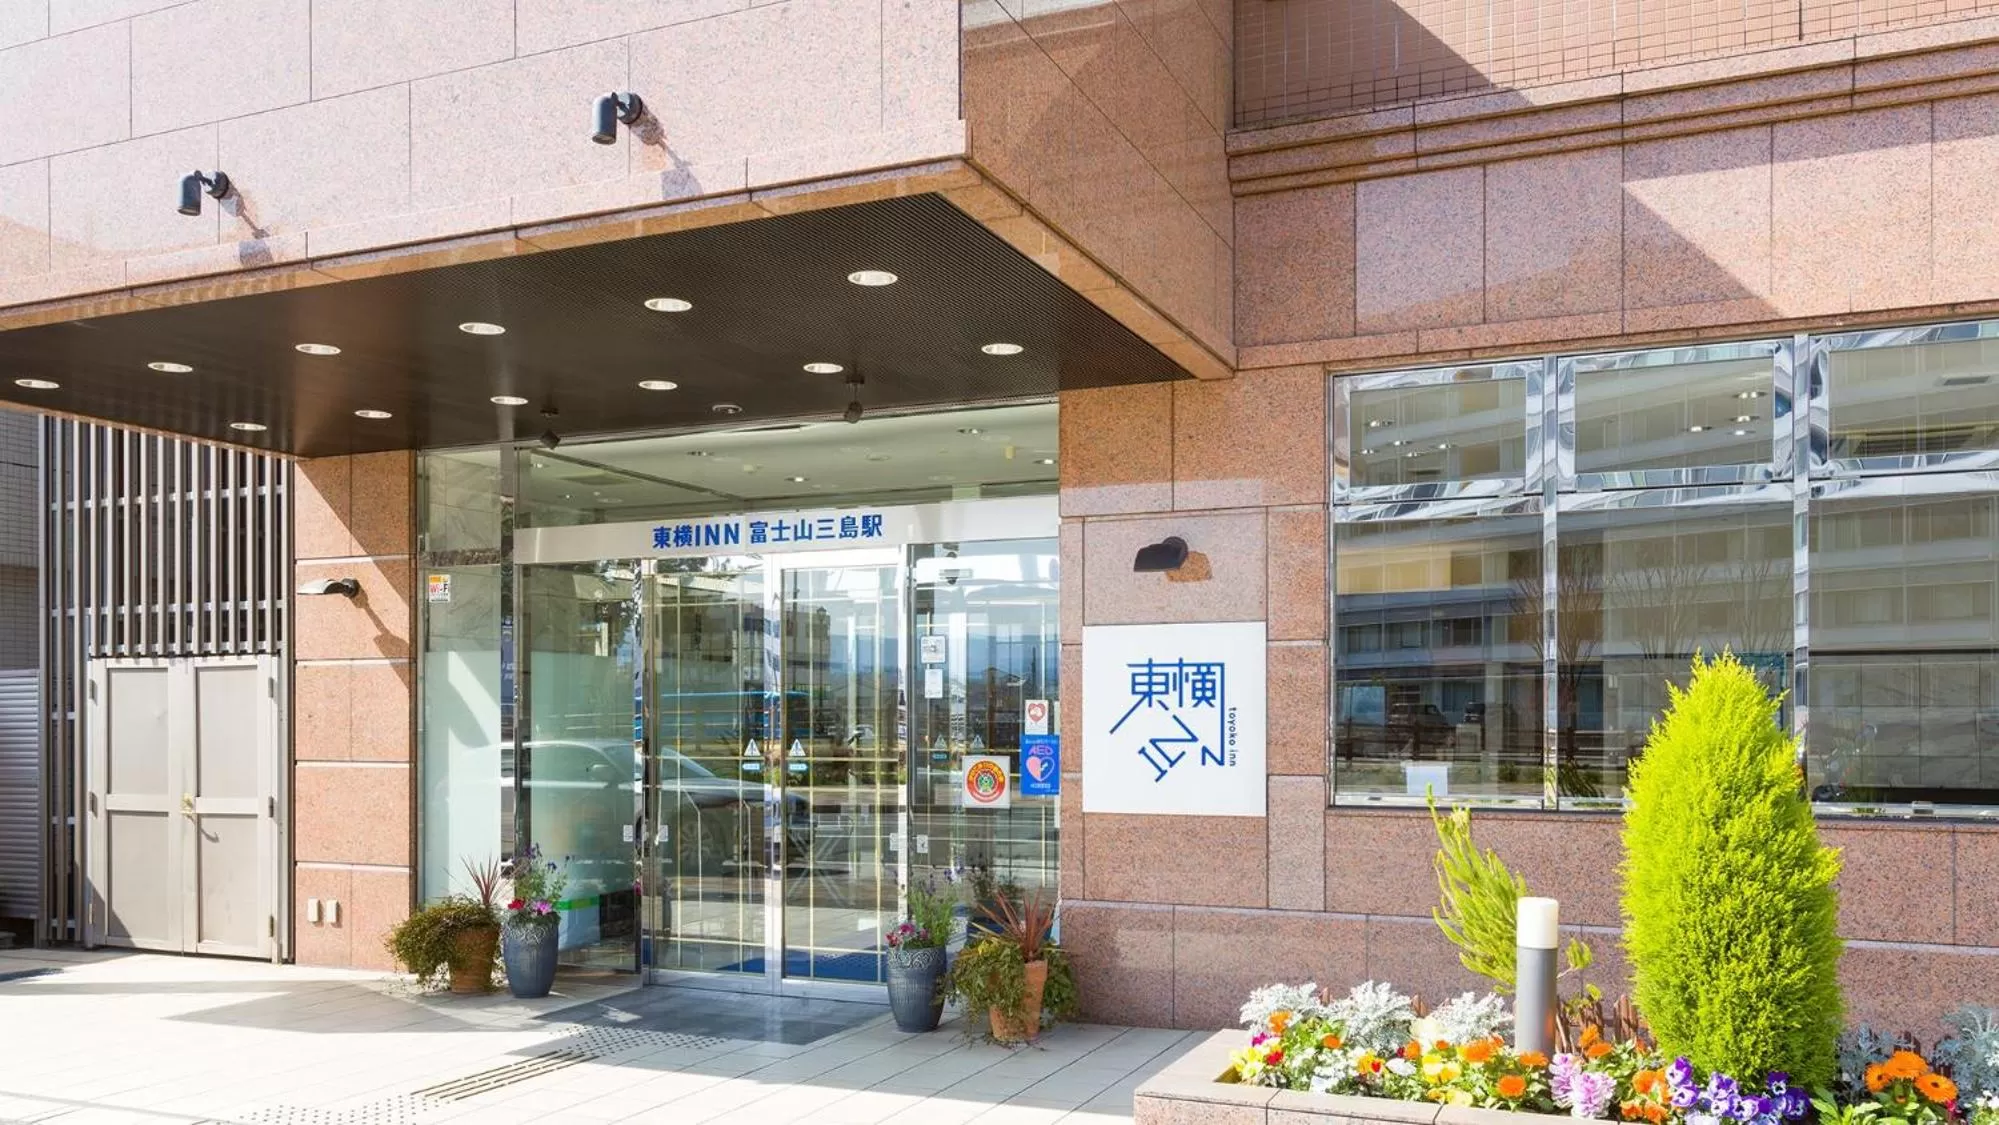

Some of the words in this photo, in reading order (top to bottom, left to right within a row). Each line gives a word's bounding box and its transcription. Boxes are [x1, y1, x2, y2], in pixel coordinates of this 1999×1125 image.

[652, 521, 740, 549] 東横INN
[749, 514, 883, 545] 富士山三島駅
[1227, 706, 1238, 746] toyoko
[1028, 744, 1055, 757] AED
[1229, 749, 1240, 767] inn
